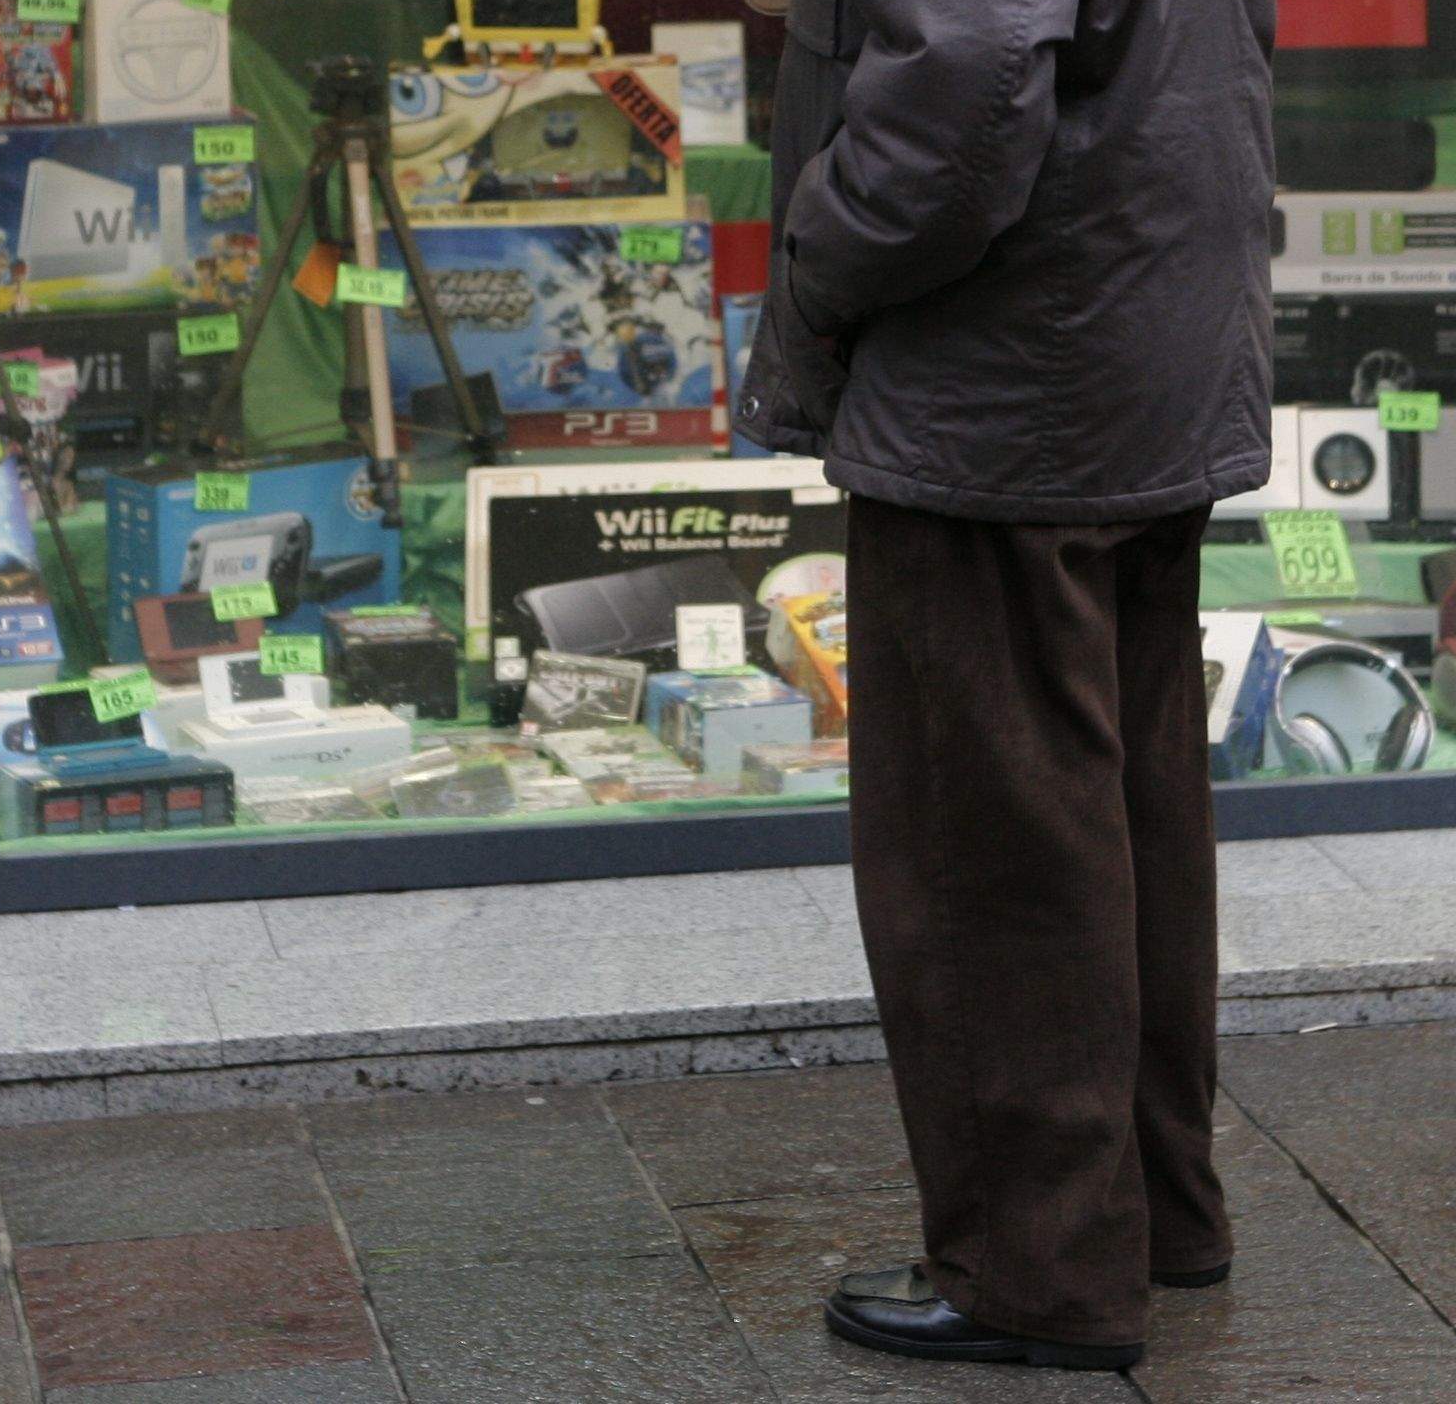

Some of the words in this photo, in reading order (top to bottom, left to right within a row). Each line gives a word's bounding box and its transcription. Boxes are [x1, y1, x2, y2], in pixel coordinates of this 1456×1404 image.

[610, 73, 679, 144] OFERTA
[197, 139, 235, 156] 150
[74, 205, 151, 245] Wii
[1320, 271, 1362, 284] Barra
[1367, 270, 1386, 284] de
[1390, 269, 1443, 284] Sonido
[185, 329, 219, 346] 150
[1386, 405, 1419, 421] 139
[563, 412, 658, 436] PS3
[595, 508, 667, 537] Wii
[670, 506, 728, 535] Fit
[729, 513, 791, 533] Plus
[620, 539, 653, 552] Wii
[654, 536, 725, 551] Balance
[1281, 546, 1340, 584] 699
[268, 647, 301, 665] 145
[100, 688, 135, 710] 165
